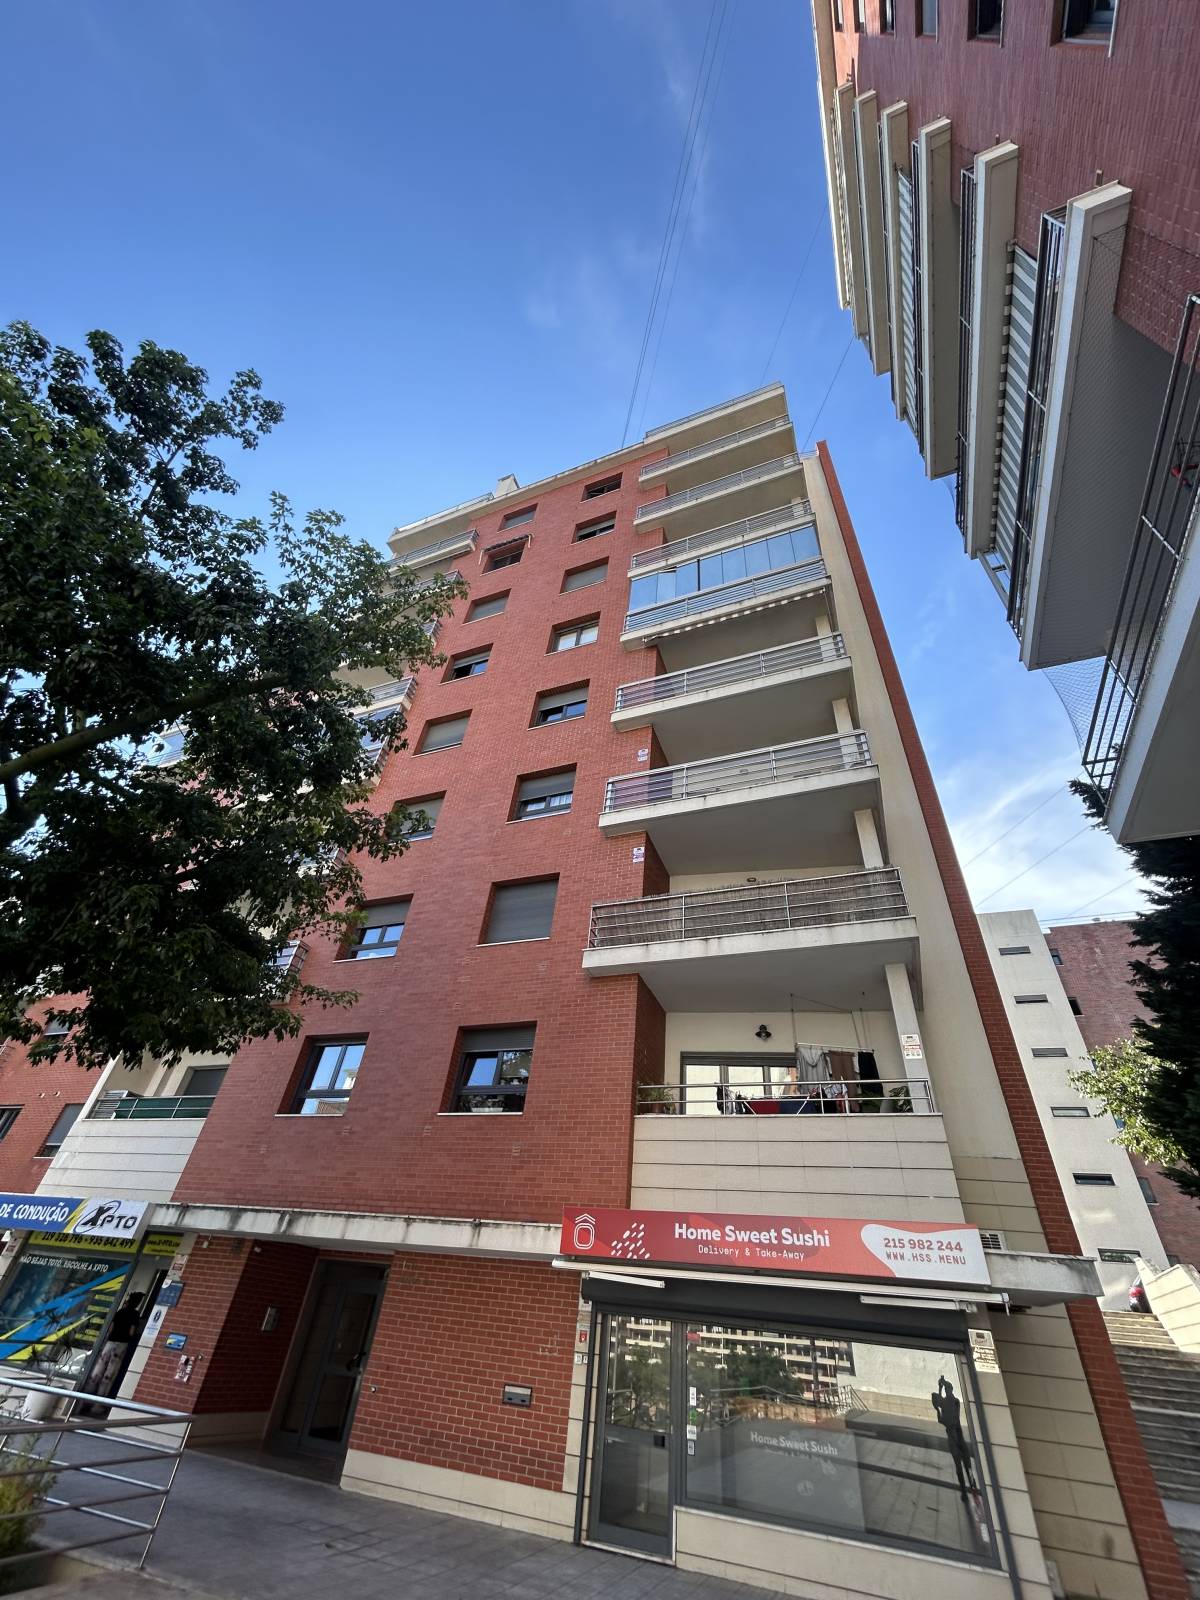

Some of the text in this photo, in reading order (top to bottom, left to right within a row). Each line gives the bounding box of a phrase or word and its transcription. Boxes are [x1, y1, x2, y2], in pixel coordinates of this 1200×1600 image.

[0, 1201, 69, 1225] DE CONDUÇÃO
[81, 1206, 138, 1229] XPTO
[674, 1223, 831, 1247] Home Sweet Sushi
[883, 1237, 963, 1252] 215 982 244
[698, 1244, 805, 1261] Delivery & Take-Away
[886, 1251, 966, 1265] WWW.HSS.MENU
[750, 1431, 779, 1446] Home
[779, 1435, 810, 1452] Sweet
